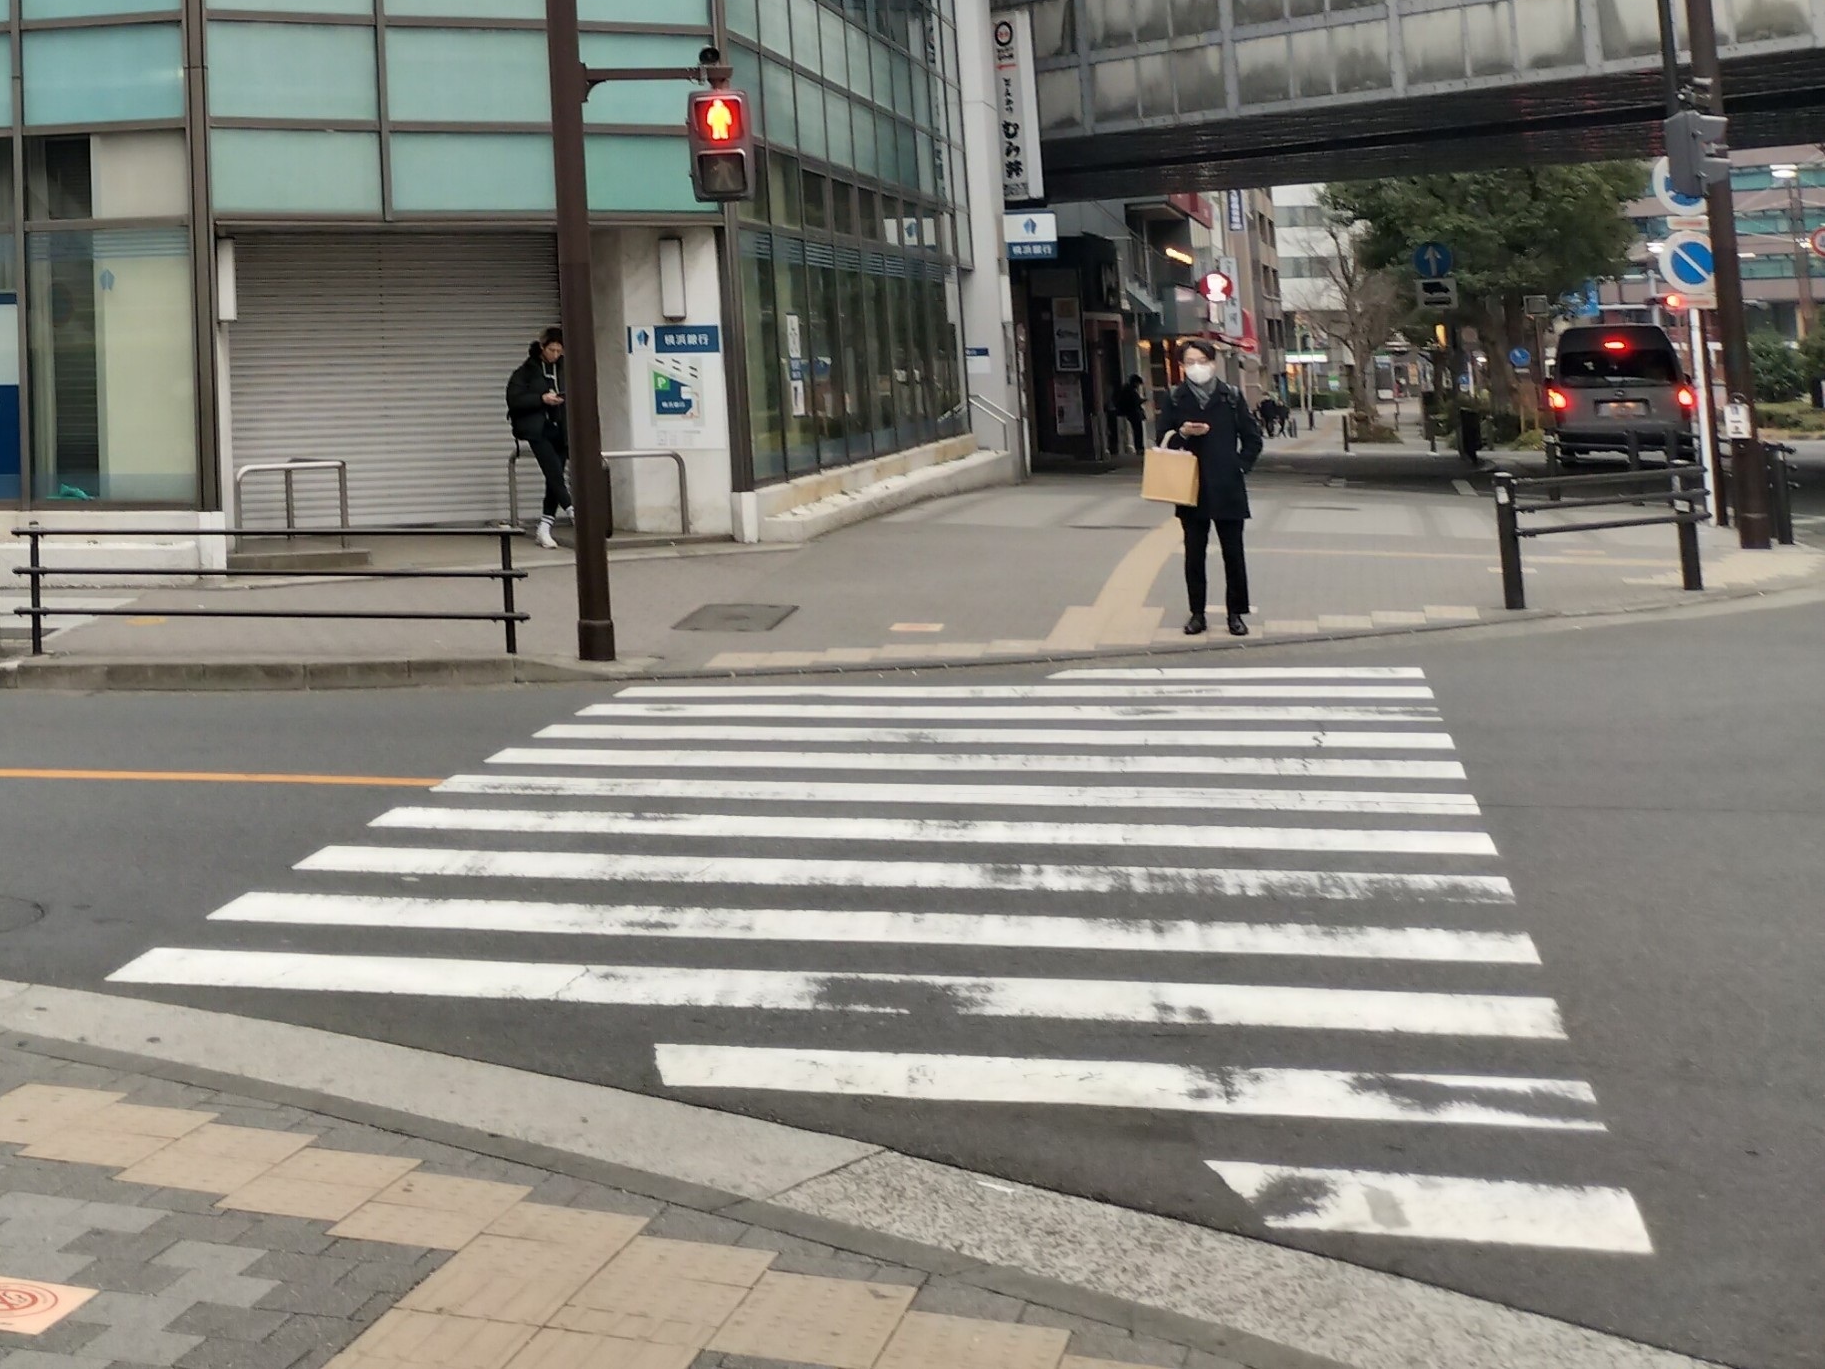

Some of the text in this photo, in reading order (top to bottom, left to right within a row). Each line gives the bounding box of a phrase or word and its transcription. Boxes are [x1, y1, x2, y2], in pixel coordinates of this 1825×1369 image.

[664, 333, 710, 347] 横浜銀行
[657, 376, 667, 389] P
